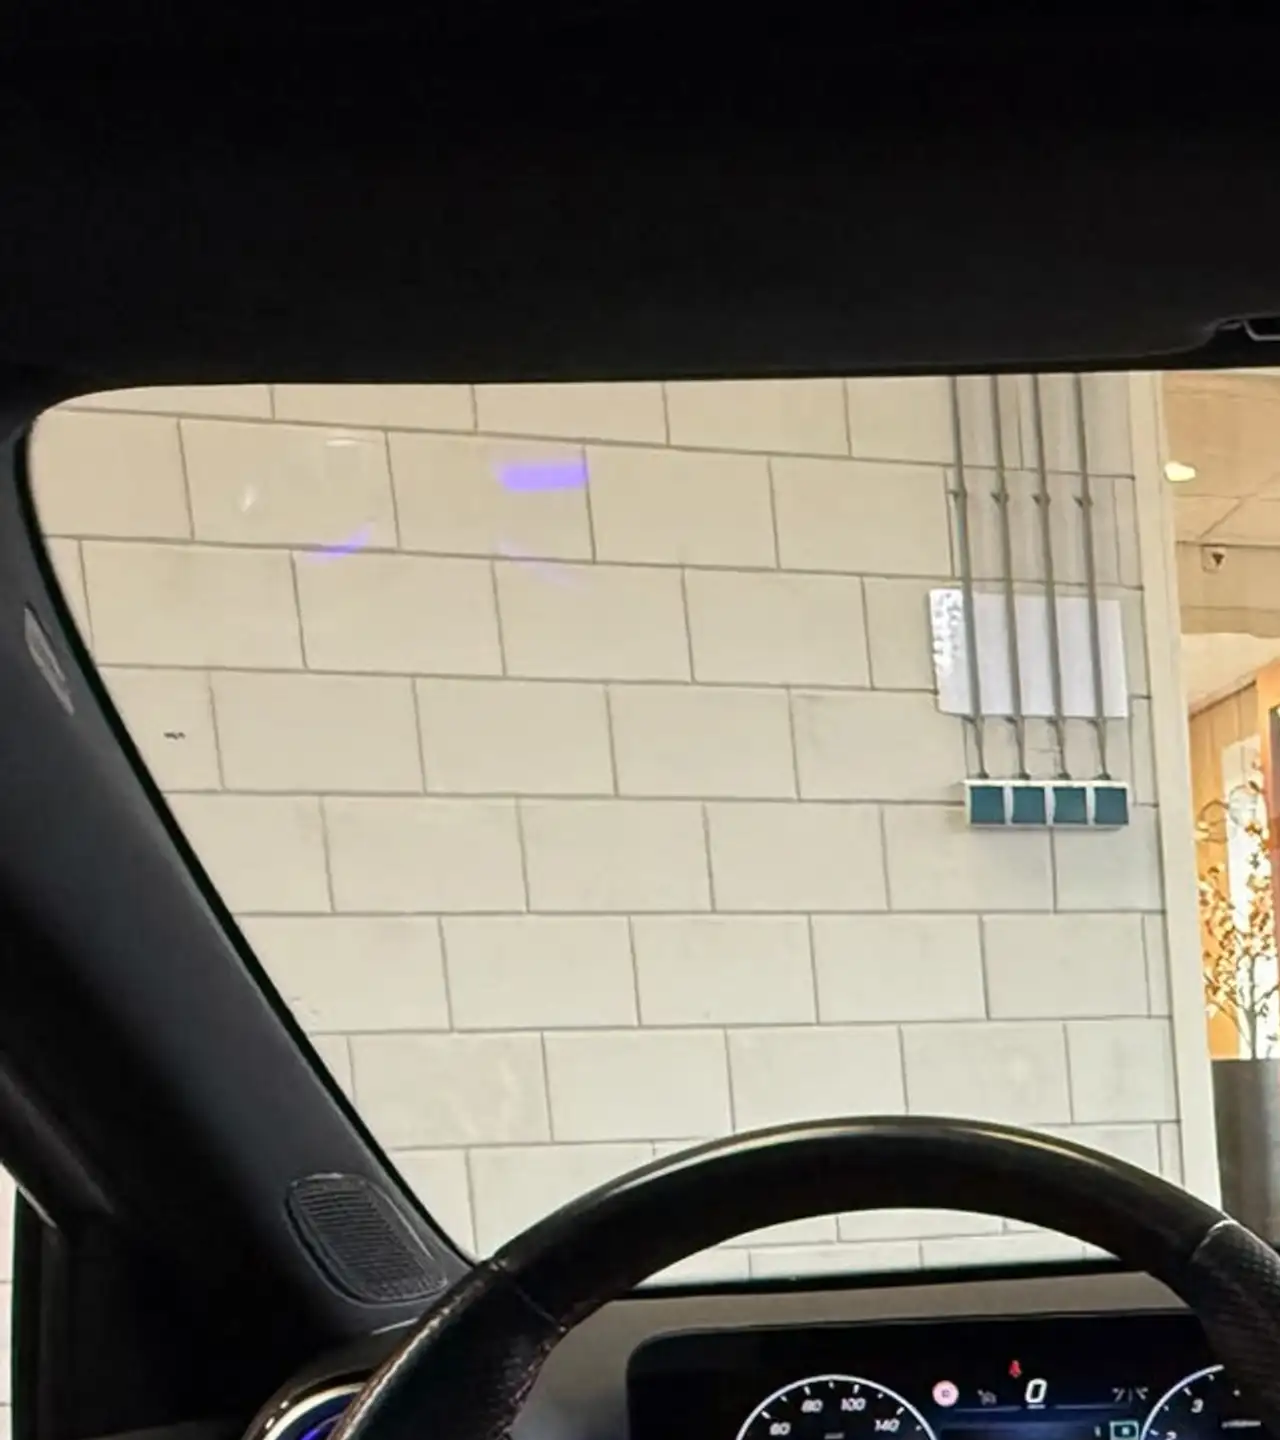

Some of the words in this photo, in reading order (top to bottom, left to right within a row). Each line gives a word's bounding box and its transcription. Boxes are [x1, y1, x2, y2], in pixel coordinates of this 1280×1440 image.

[1025, 1378, 1048, 1403] 0
[841, 1398, 866, 1411] 100
[1191, 1399, 1204, 1413] 3
[874, 1419, 900, 1432] 140
